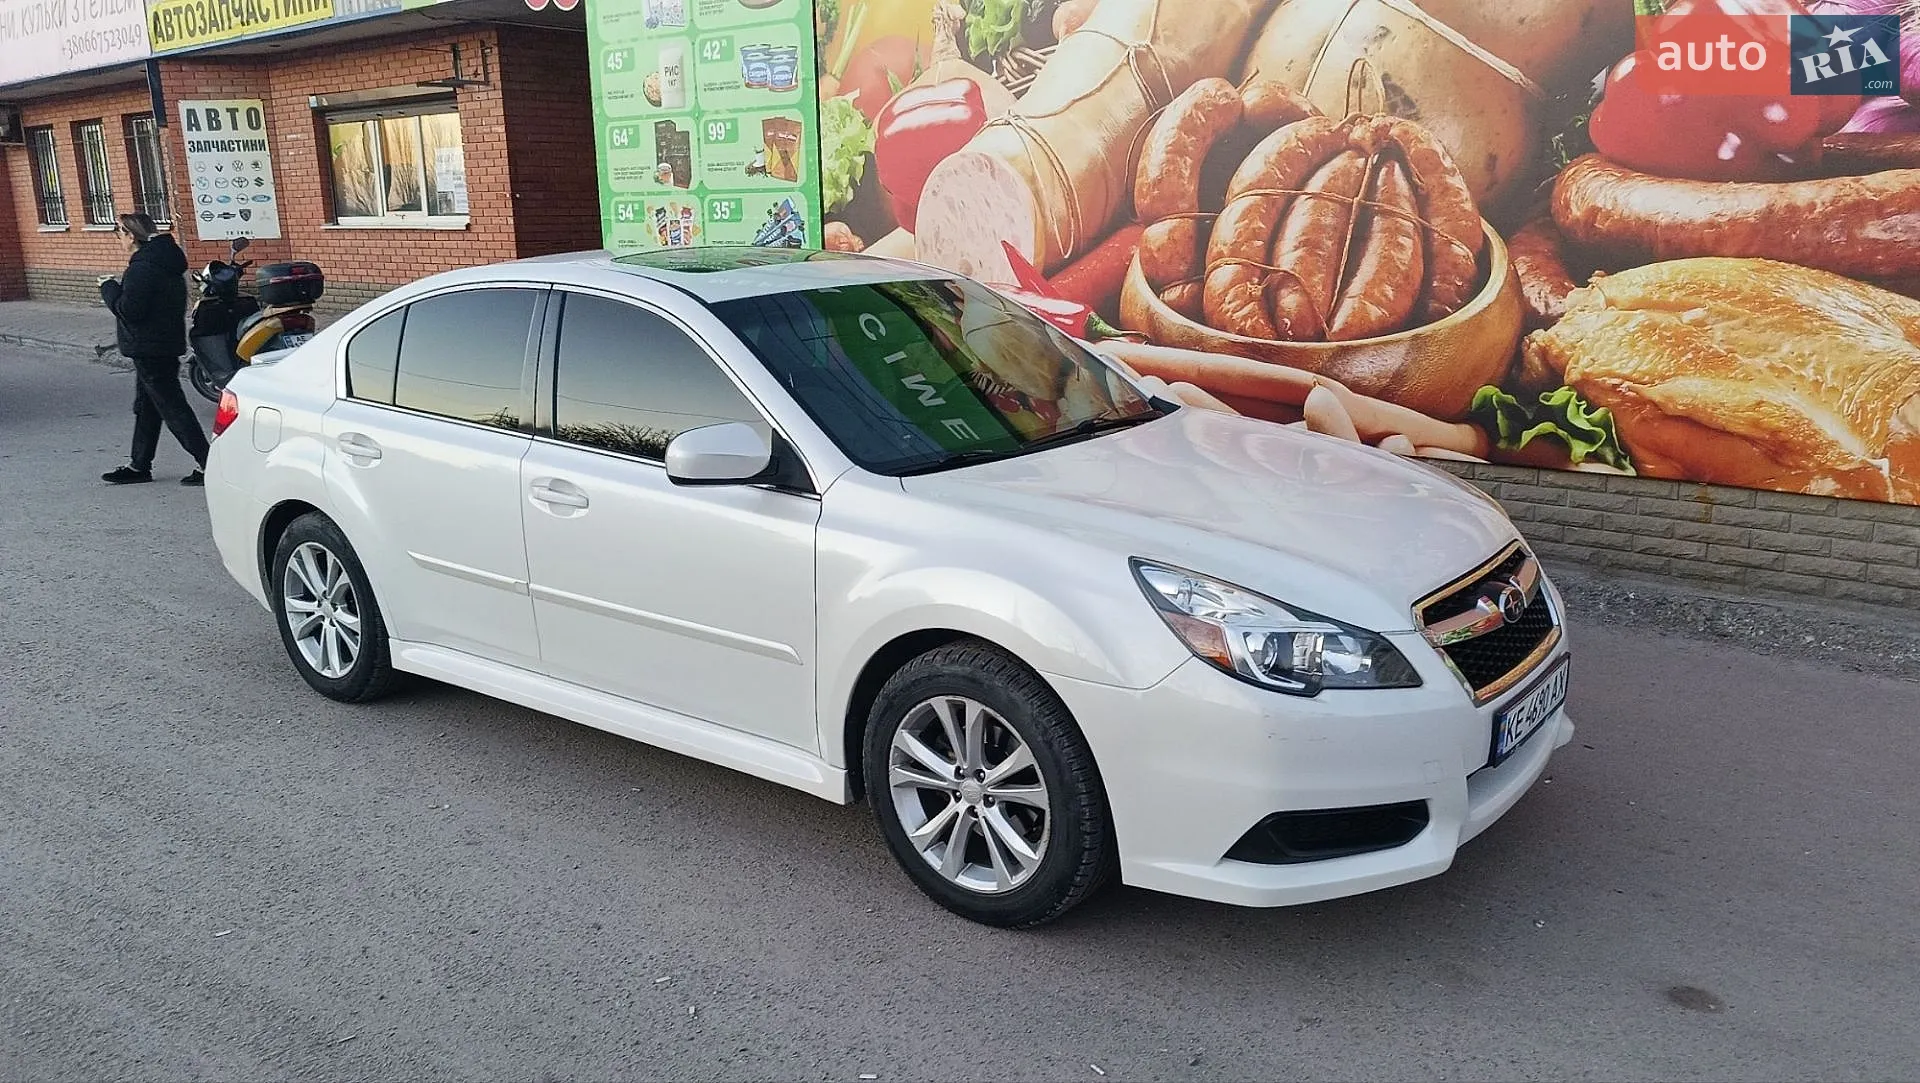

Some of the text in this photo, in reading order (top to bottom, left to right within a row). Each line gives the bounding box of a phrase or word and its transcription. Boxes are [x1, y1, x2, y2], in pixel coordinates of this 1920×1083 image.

[153, 0, 328, 44] АВТОЗАПЧАСТ
[186, 106, 261, 132] АВТО
[188, 139, 267, 153] ЗАПЧАСТИНИ
[1505, 706, 1525, 747] KE
